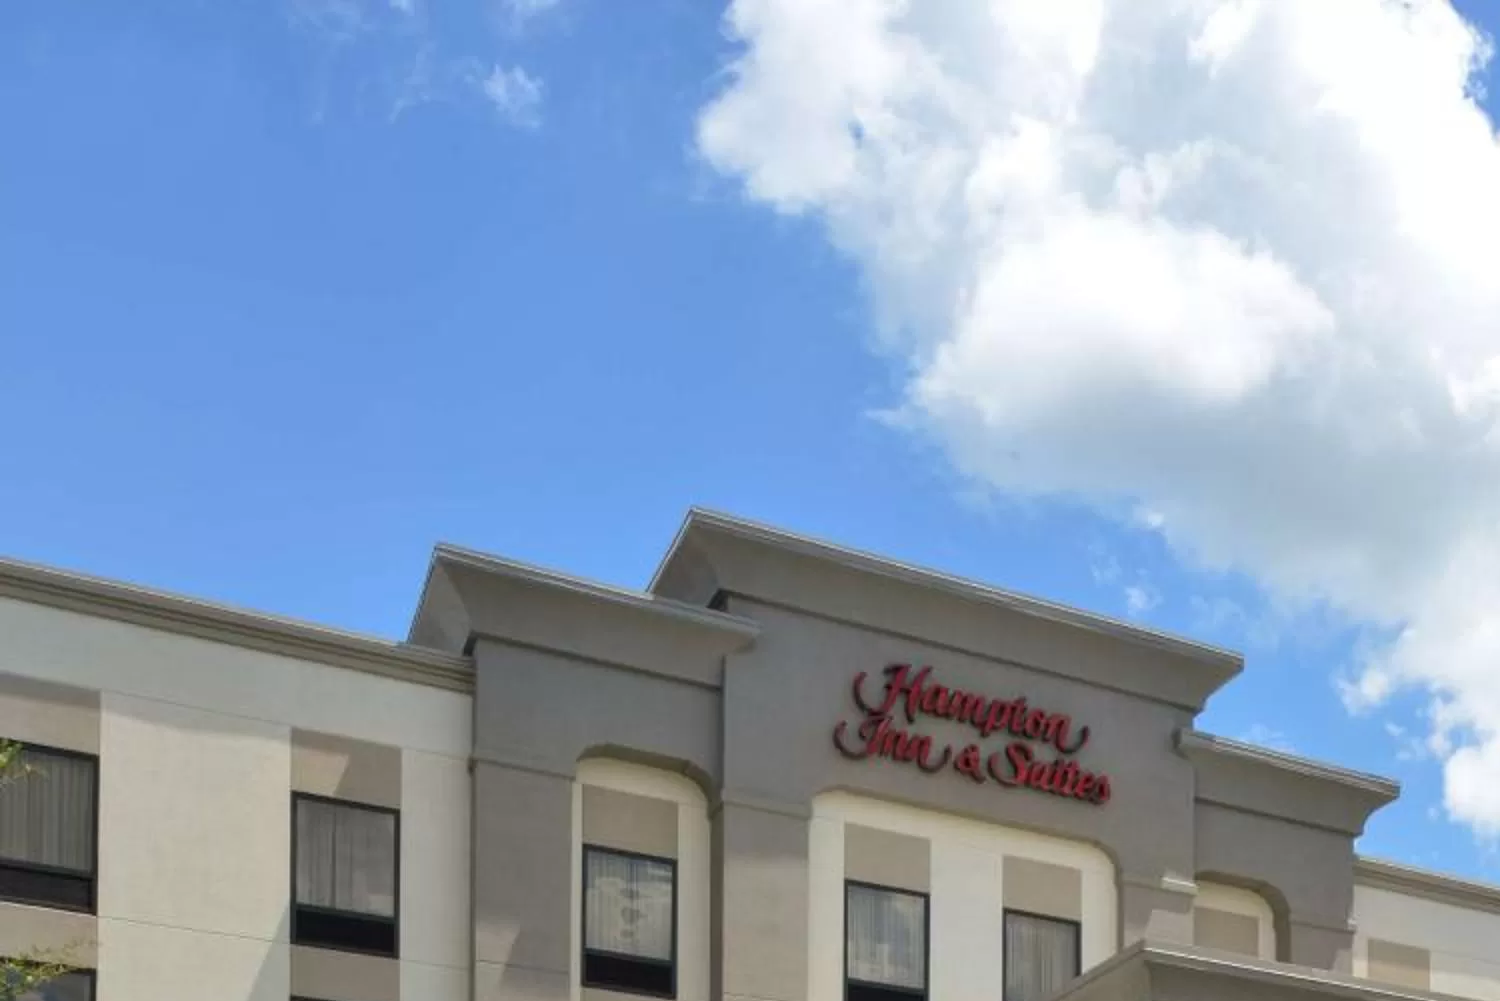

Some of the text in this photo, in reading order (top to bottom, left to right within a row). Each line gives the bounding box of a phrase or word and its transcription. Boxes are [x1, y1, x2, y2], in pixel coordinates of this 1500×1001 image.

[853, 663, 1089, 754] Hampton
[833, 715, 1111, 805] Inn & Suites
